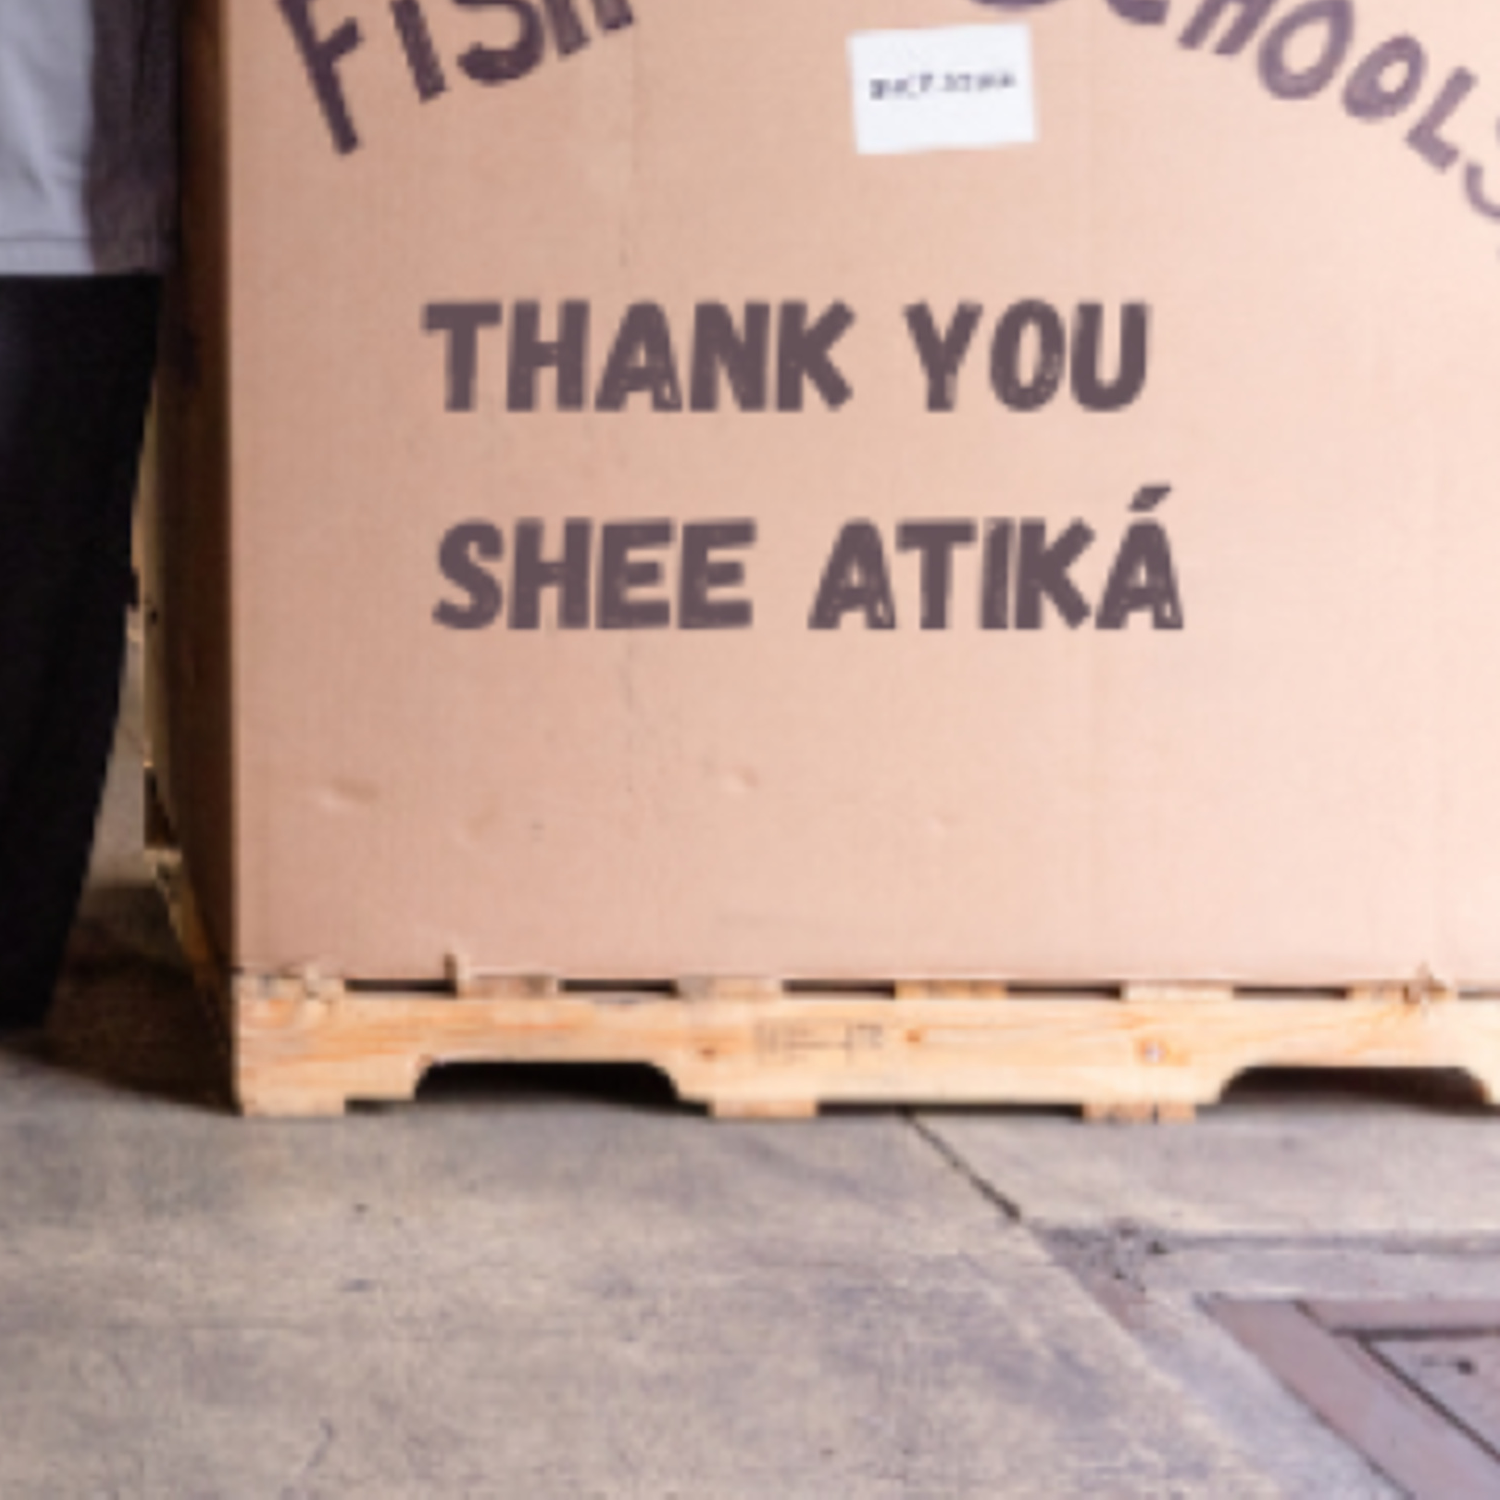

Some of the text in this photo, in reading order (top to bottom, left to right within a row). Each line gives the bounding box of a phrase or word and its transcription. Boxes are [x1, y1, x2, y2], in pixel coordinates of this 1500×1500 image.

[420, 299, 1150, 413] THANK YOU
[430, 485, 1184, 631] SHEE ATIKÁ
